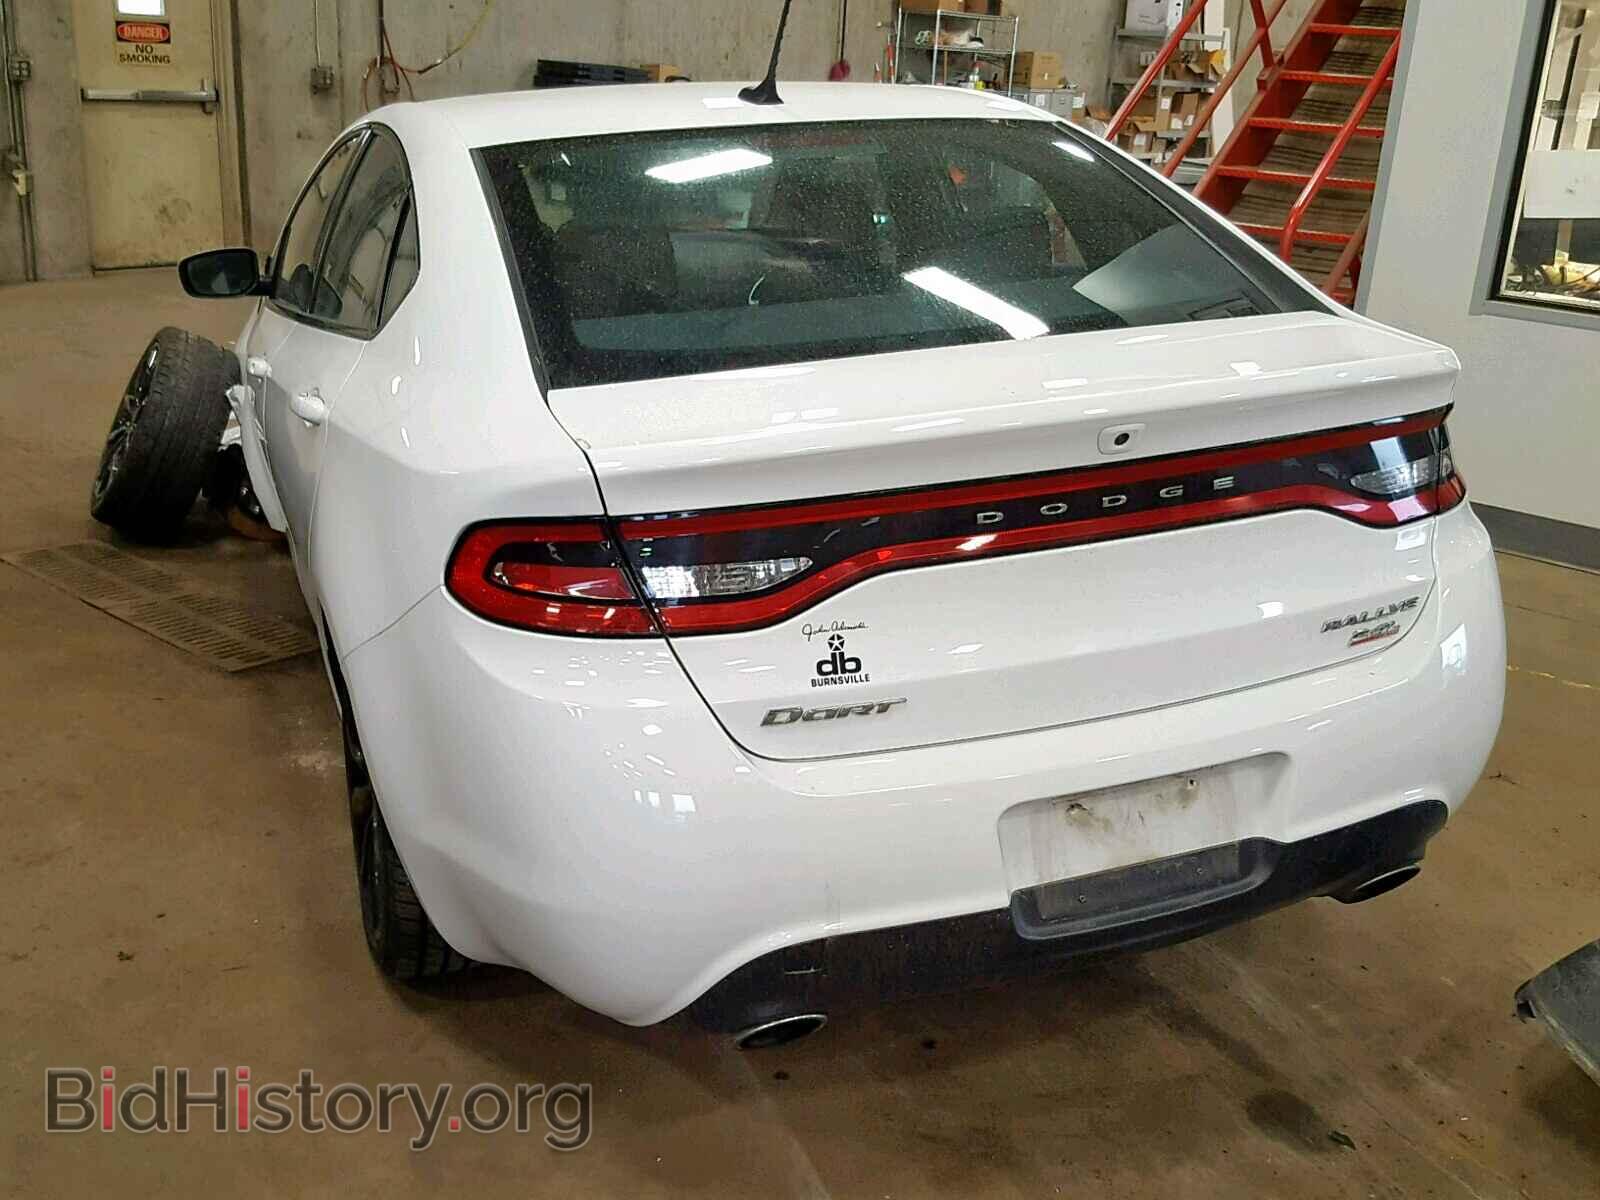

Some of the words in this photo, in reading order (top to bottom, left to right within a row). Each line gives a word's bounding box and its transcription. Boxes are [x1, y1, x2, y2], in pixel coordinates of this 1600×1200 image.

[123, 25, 163, 40] DANGER
[135, 44, 154, 54] NO
[119, 54, 171, 65] SMOKING
[977, 476, 1235, 525] DODGE
[816, 651, 862, 676] db
[810, 673, 871, 688] BURNSVILLE
